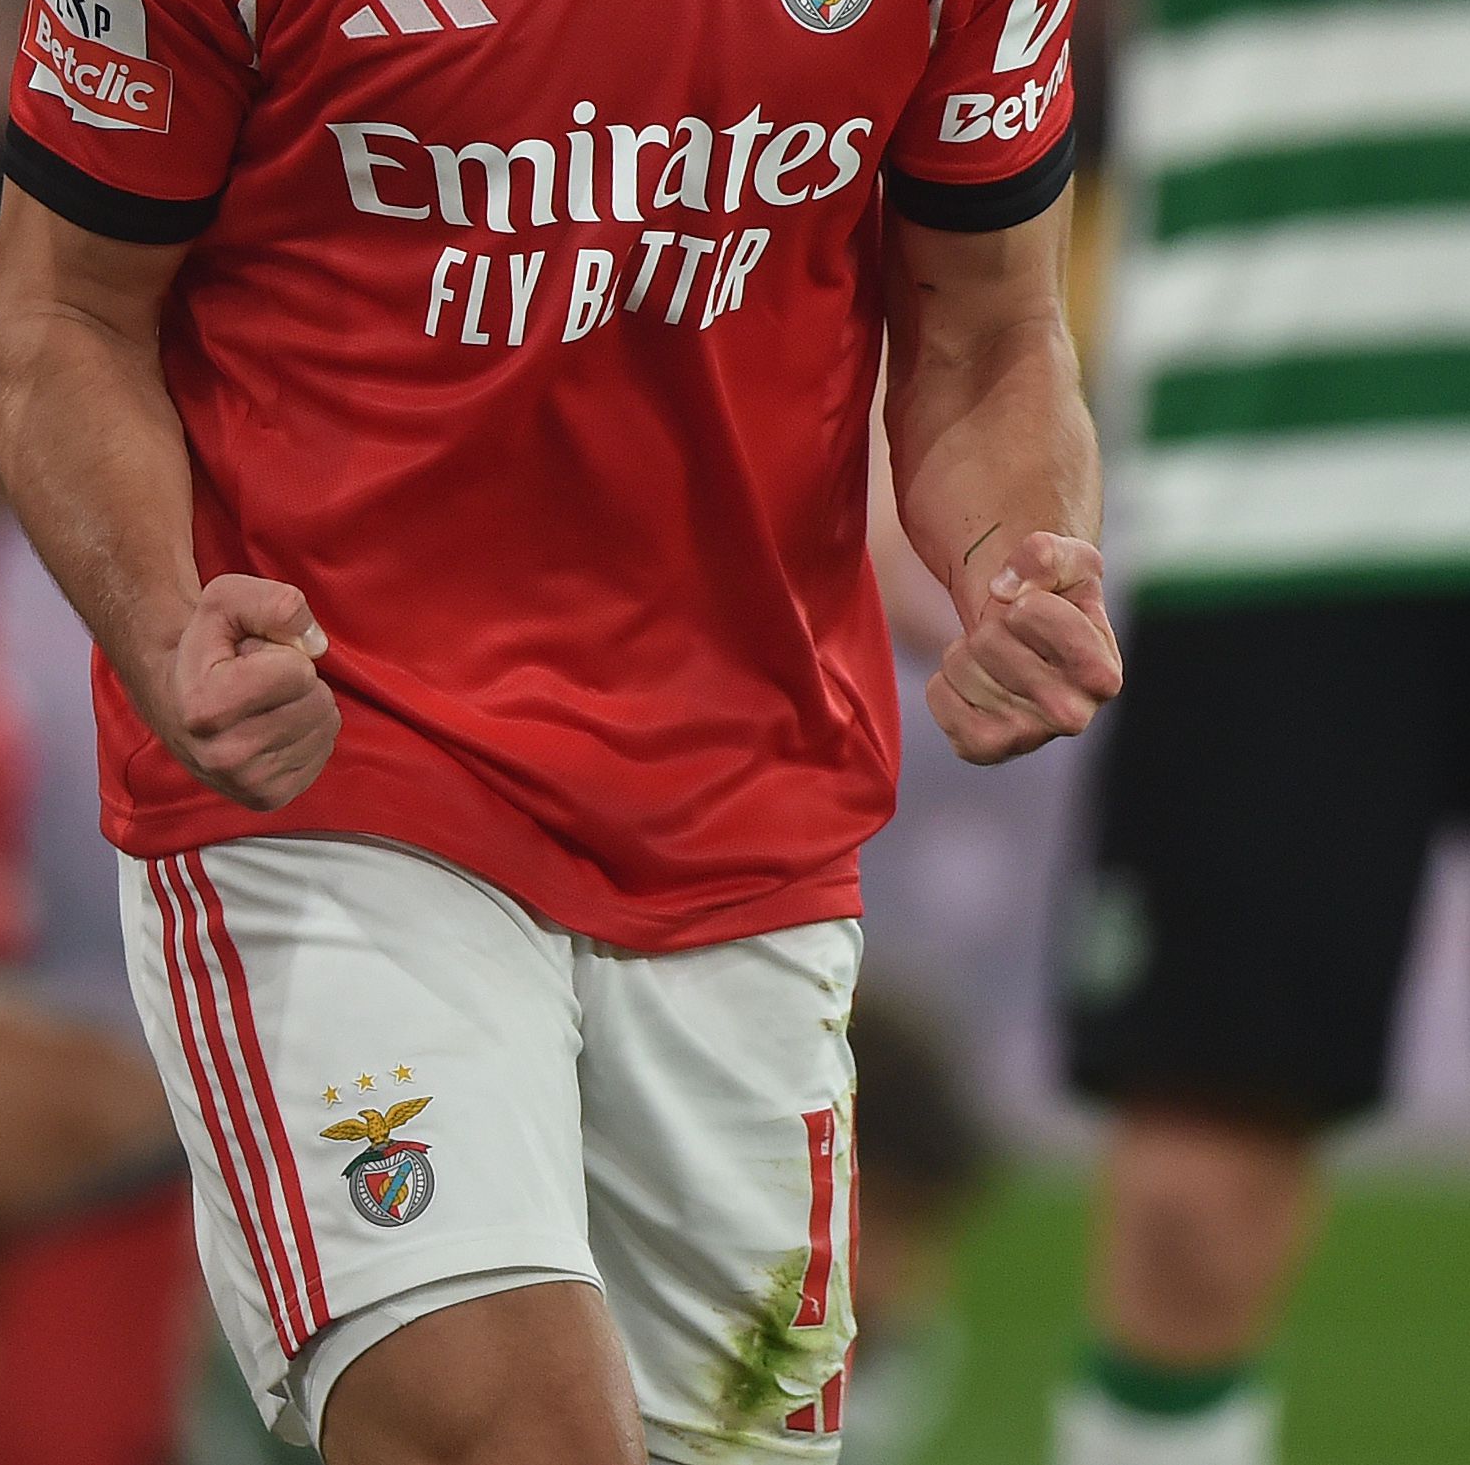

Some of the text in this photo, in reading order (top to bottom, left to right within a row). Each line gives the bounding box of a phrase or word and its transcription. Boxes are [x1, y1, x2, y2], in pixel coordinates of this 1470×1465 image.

[35, 9, 155, 111] Betclic
[325, 100, 874, 234] Emirates
[424, 228, 771, 347] FLY BTTER
